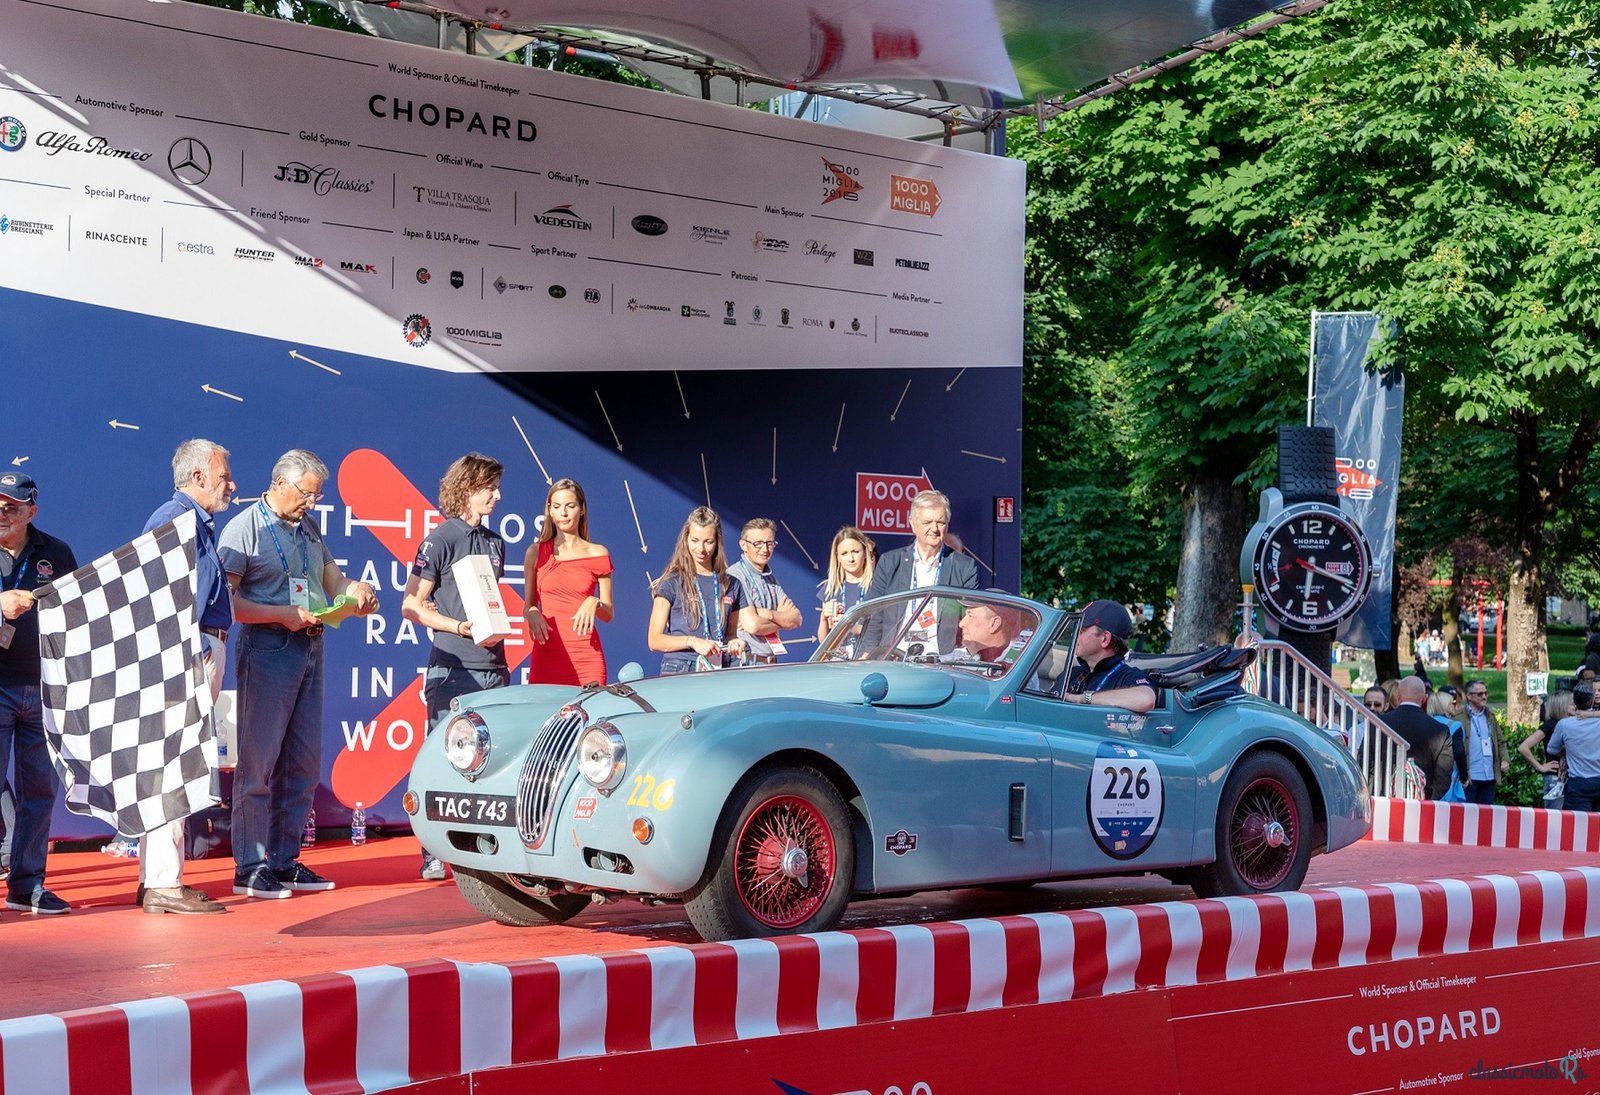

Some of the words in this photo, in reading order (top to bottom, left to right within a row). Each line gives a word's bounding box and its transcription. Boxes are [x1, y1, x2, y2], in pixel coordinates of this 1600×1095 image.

[388, 63, 411, 76] World
[413, 68, 442, 80] Sponsor
[444, 74, 450, 82] &
[452, 75, 479, 88] Official
[480, 79, 520, 96] Timekeeper
[75, 94, 127, 112] Automotive
[129, 103, 164, 117] Sponsor
[368, 94, 537, 142] CHOPARD
[36, 131, 84, 156] Alfa
[84, 136, 152, 162] Romeo
[299, 131, 318, 142] Gold
[320, 134, 351, 147] Sponsor
[436, 153, 463, 166] Official
[464, 158, 483, 169] Wine
[824, 163, 859, 176] 1000
[313, 167, 374, 196] Classics
[547, 171, 573, 183] Official
[574, 175, 589, 187] Tyre
[822, 175, 860, 189] MIGLIA
[84, 185, 115, 199] Special
[118, 190, 151, 203] Partner
[823, 187, 859, 201] 2018
[896, 180, 929, 196] 1000
[427, 188, 450, 201] VILLA
[452, 192, 491, 206] TRASQUA
[893, 195, 931, 213] MIGLIA
[250, 207, 277, 220] Friend
[278, 211, 310, 224] Sponsor
[764, 205, 780, 215] Main
[781, 207, 805, 218] Sponsor
[533, 214, 592, 231] VREDESTEIN
[692, 225, 731, 236] KIENLE
[85, 230, 148, 246] RINASCENTE
[402, 227, 424, 240] Japan
[426, 230, 432, 240] &
[434, 231, 452, 242] USA
[453, 234, 480, 246] Partner
[187, 243, 214, 255] estra
[235, 247, 275, 258] HUNTER
[531, 245, 550, 257] Sport
[551, 247, 578, 259] Partner
[340, 262, 375, 272] MAK
[731, 270, 758, 282] Patrocini
[509, 283, 534, 292] SPORT
[585, 289, 600, 301] FIA
[892, 292, 910, 301] Media
[911, 294, 931, 304] Partner
[803, 318, 823, 327] ROMA
[1338, 475, 1377, 486] GLIA
[866, 481, 919, 501] 1000
[861, 508, 911, 529] MIGLI
[1301, 519, 1322, 534] 12
[1302, 601, 1318, 616] 6
[351, 667, 394, 698] IN
[1103, 766, 1150, 800] 226
[627, 775, 677, 812] 226
[435, 796, 471, 819] TAC
[476, 799, 508, 822] 743
[579, 799, 594, 807] 1000
[1359, 986, 1381, 998] World
[1381, 984, 1408, 999] Sponsor
[1409, 981, 1416, 992] &
[1416, 978, 1440, 991] Official
[1440, 975, 1477, 988] Timekeeper
[1347, 1006, 1501, 1056] CHOPARD
[1400, 1074, 1438, 1090] Automotive
[1438, 1071, 1464, 1086] Sponsor
